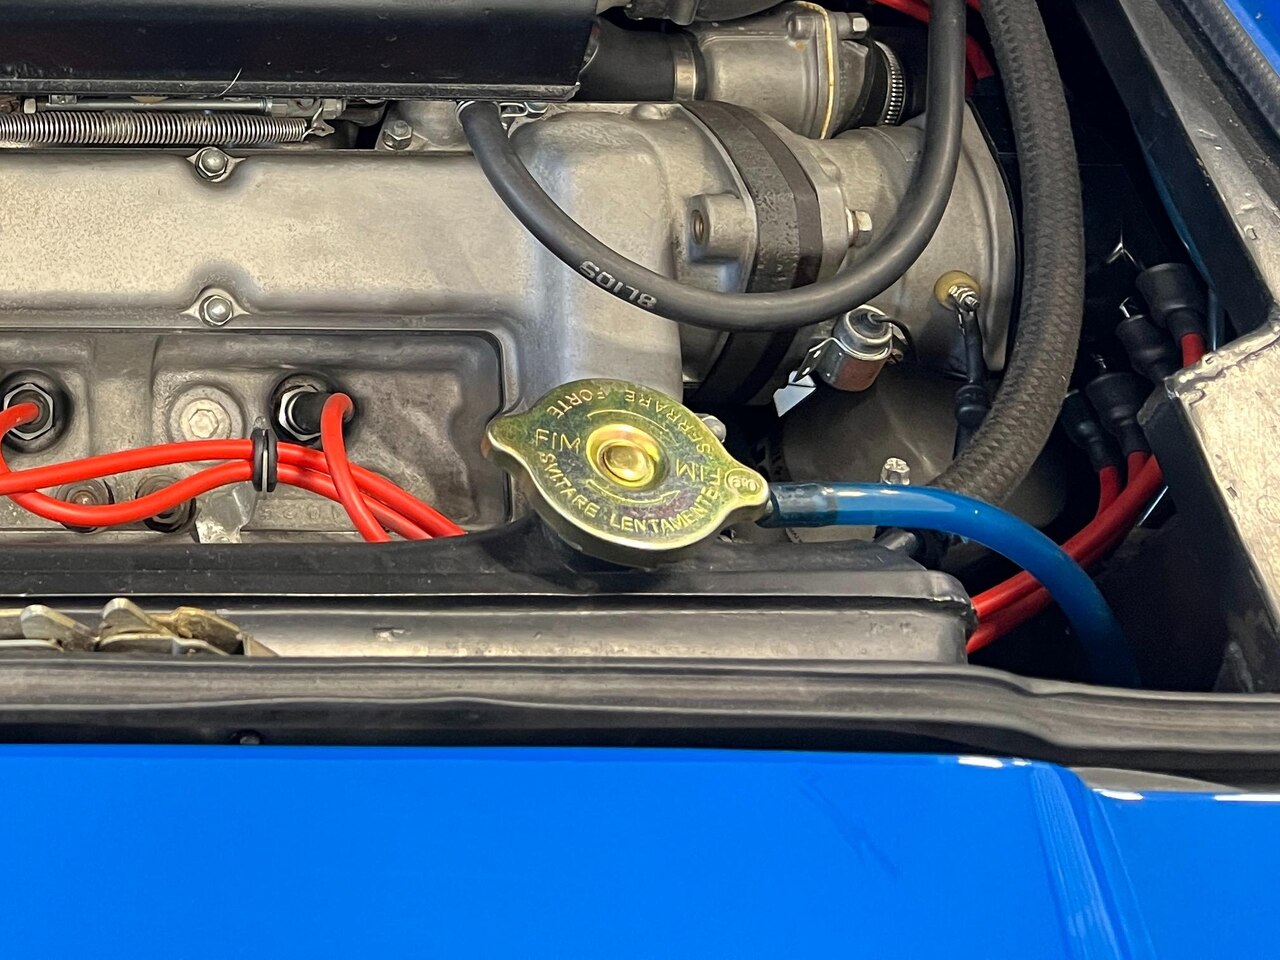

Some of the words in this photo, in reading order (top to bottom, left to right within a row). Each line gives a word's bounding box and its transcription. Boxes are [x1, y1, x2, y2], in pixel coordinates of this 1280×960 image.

[547, 389, 610, 419] FORTE
[624, 390, 713, 453] SERRARE
[536, 428, 581, 454] FIM
[676, 459, 720, 487] FIM
[540, 452, 600, 518] SVITARE
[610, 485, 720, 534] LENTAMENTE
